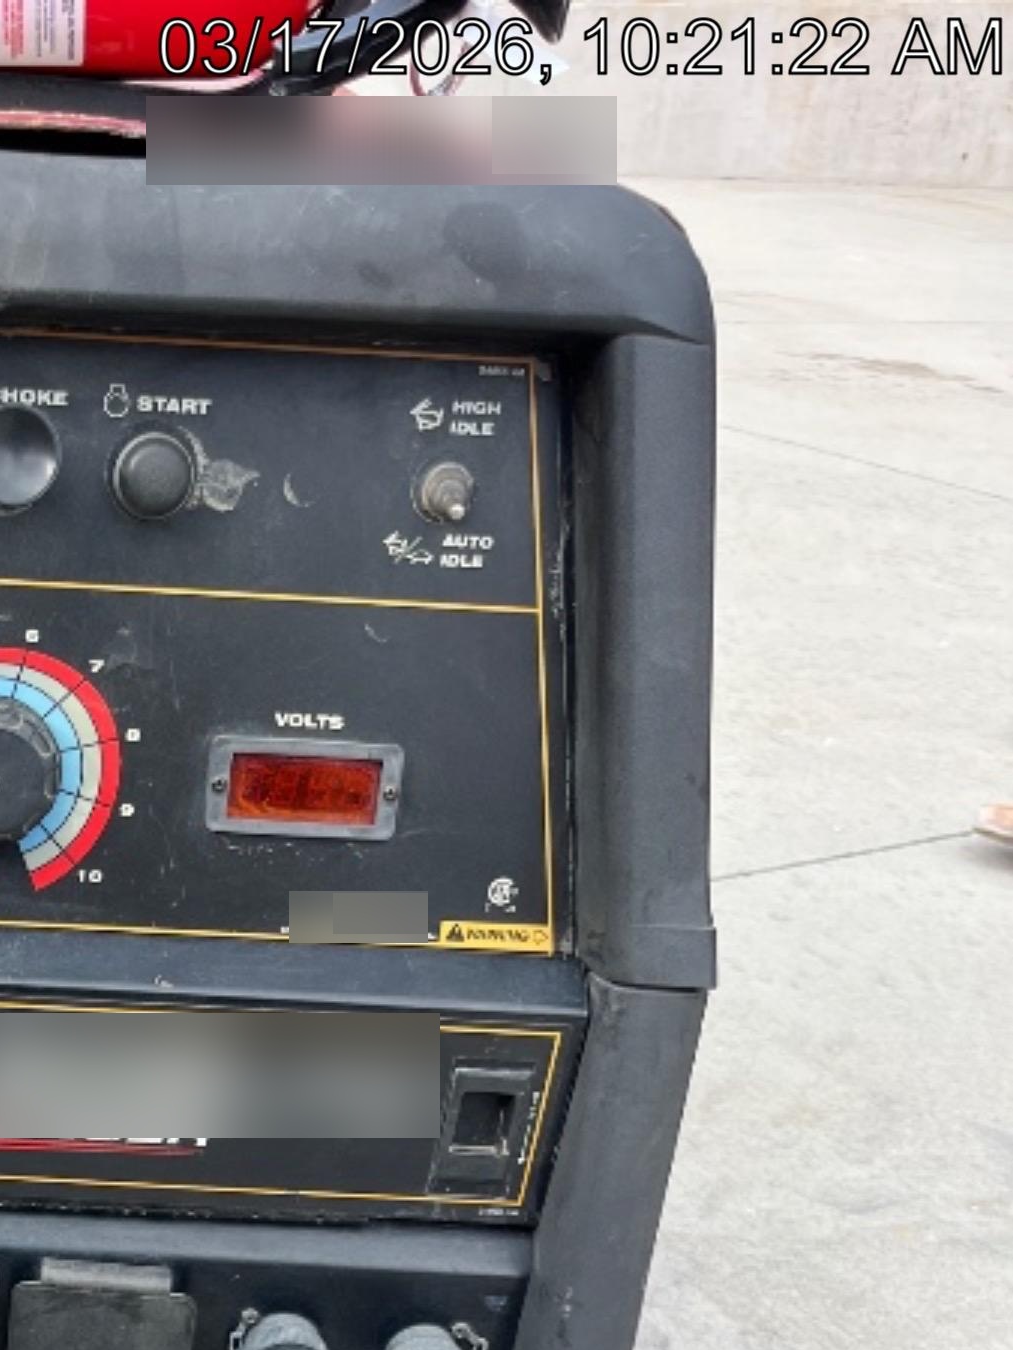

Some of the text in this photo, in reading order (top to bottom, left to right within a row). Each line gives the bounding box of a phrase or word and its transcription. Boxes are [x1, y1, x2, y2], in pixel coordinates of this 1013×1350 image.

[136, 395, 212, 415] START
[451, 400, 502, 415] HIGH
[449, 421, 495, 436] IDLE
[442, 533, 495, 550] AUTO
[439, 553, 484, 568] IDLE
[25, 629, 40, 643] 6
[88, 659, 105, 673] 7
[274, 712, 345, 730] VOLTS
[125, 728, 141, 742] 8
[119, 803, 135, 817] 9
[78, 869, 103, 884] 10
